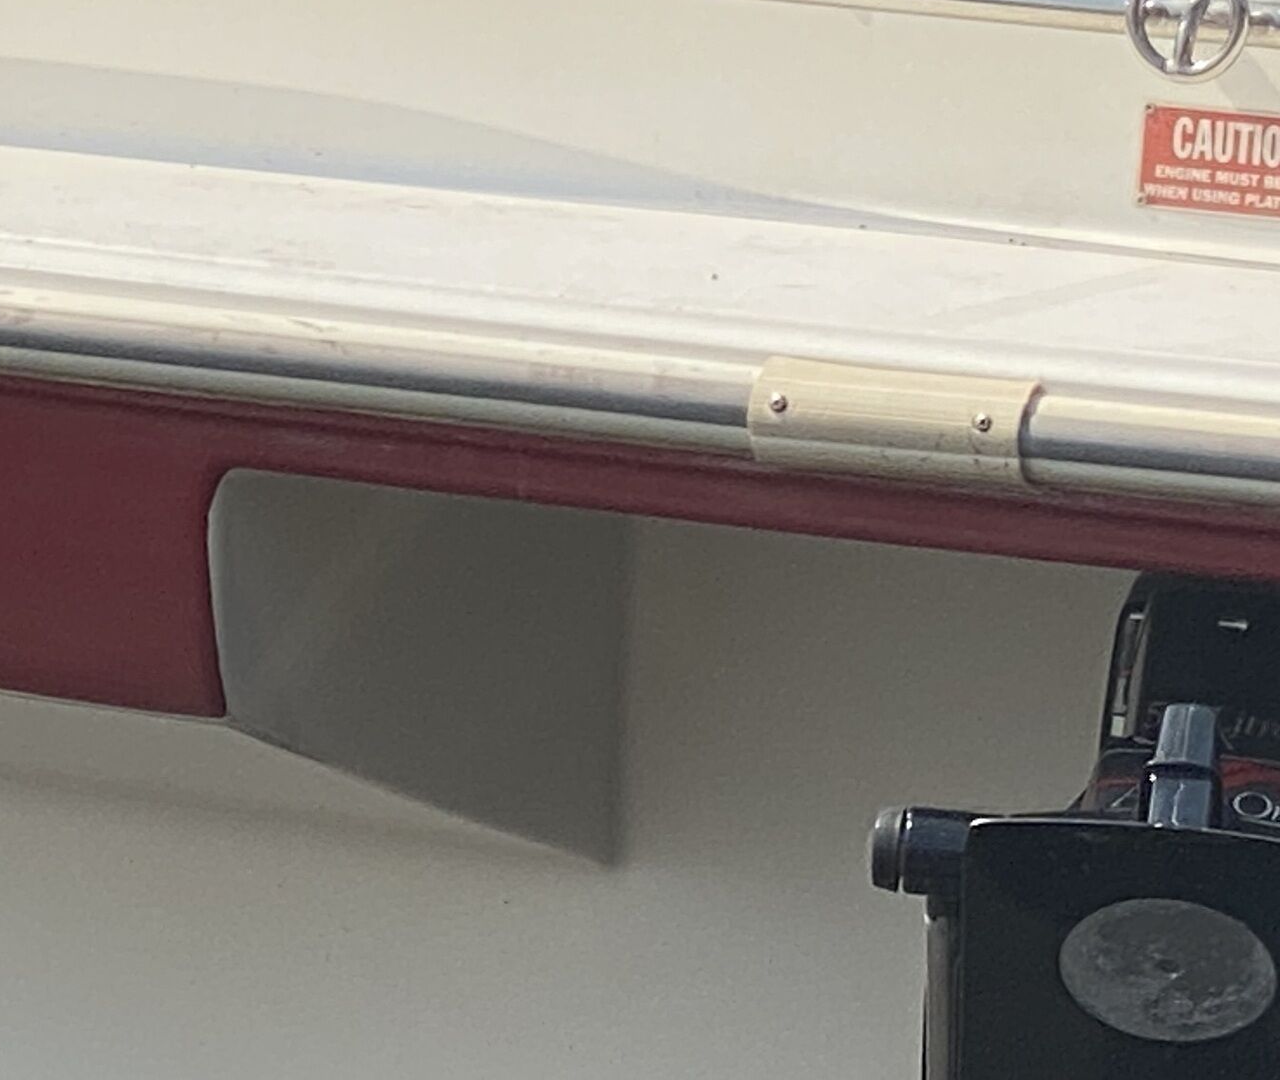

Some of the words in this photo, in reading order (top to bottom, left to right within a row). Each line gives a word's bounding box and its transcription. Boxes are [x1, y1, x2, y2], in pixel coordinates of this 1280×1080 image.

[1155, 164, 1211, 183] ENGINE
[1215, 172, 1259, 188] MUST
[1144, 183, 1188, 201] WHEN
[1192, 188, 1240, 206] USING
